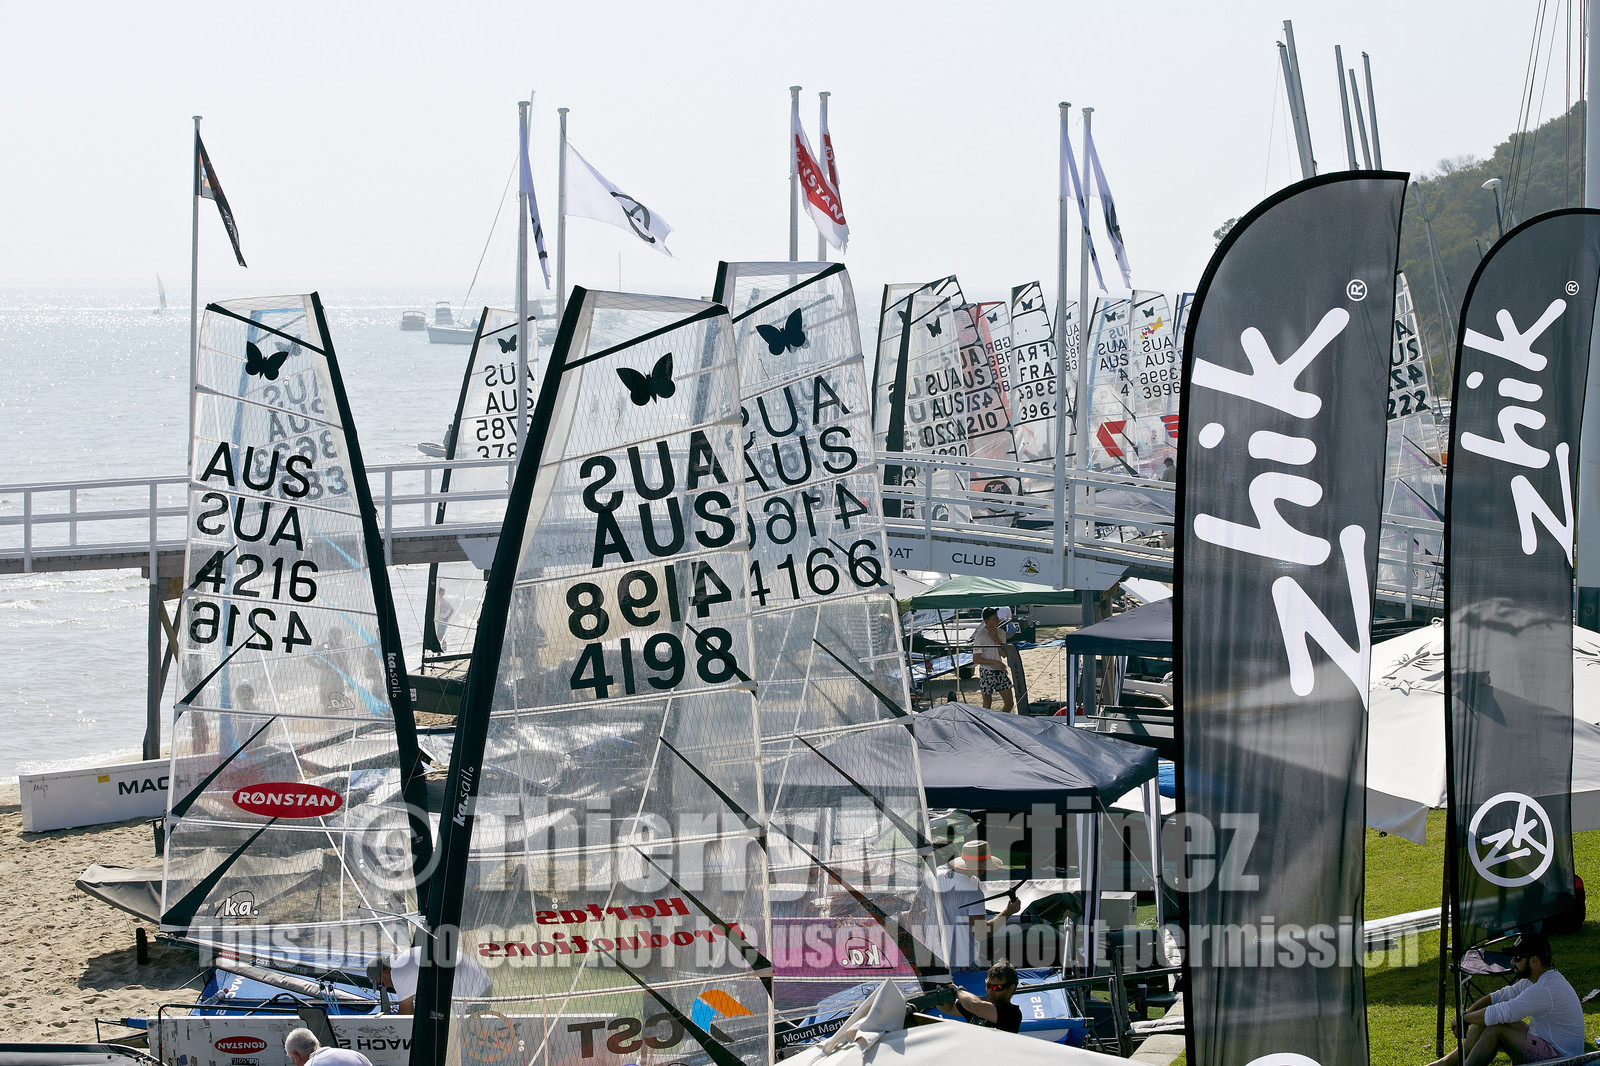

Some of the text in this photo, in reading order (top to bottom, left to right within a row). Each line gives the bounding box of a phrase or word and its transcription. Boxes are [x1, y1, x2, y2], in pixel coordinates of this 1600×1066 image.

[1100, 353, 1129, 371] AUS
[1145, 351, 1176, 368] AUS
[1020, 362, 1055, 383] FRA
[200, 442, 313, 498] AUS
[593, 491, 736, 569] AUS
[951, 552, 996, 567] CLUB
[197, 551, 319, 602] 4216
[569, 627, 739, 700] 4198
[238, 791, 337, 808] RONSTAN
[783, 1026, 816, 1045] Mount
[218, 1041, 265, 1050] RONSTAN
